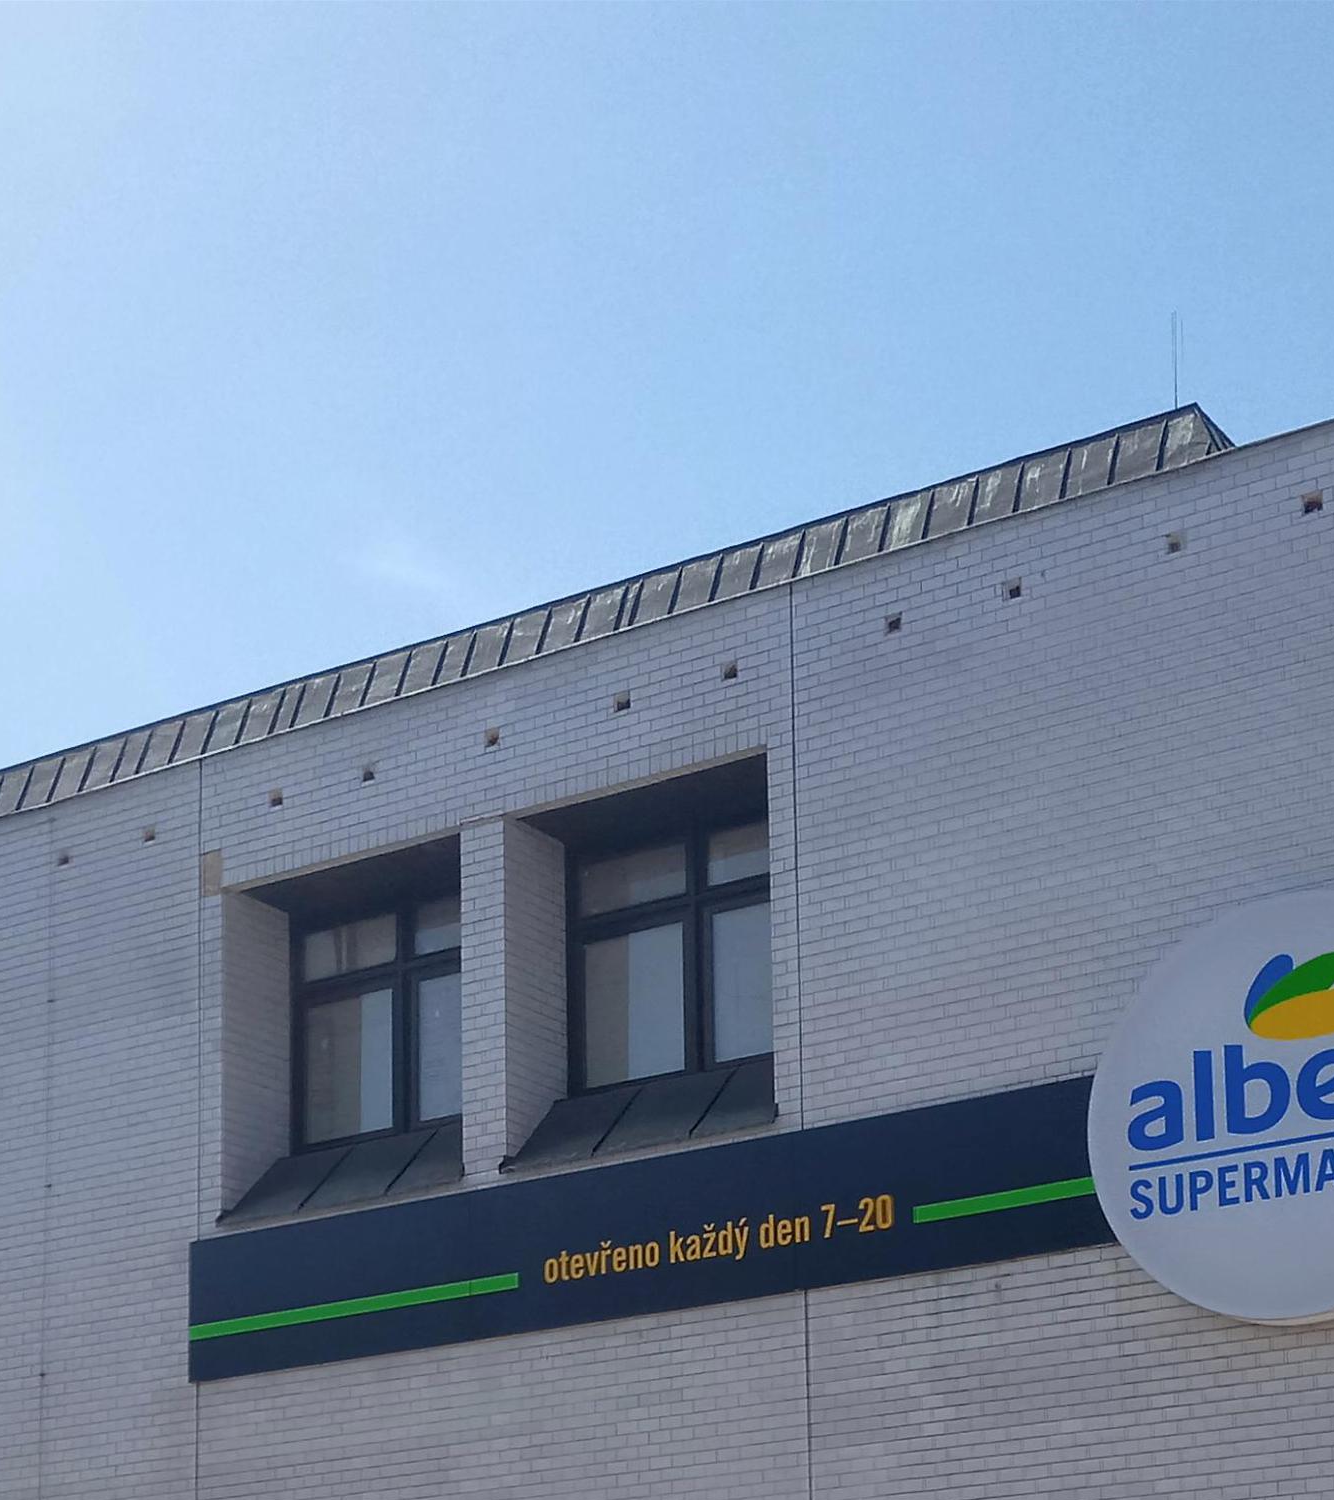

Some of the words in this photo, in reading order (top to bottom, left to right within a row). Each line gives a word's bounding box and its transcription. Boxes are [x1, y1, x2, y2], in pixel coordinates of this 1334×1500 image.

[544, 1240, 660, 1284] otevřeno
[669, 1216, 749, 1263] každý
[759, 1213, 810, 1249] den
